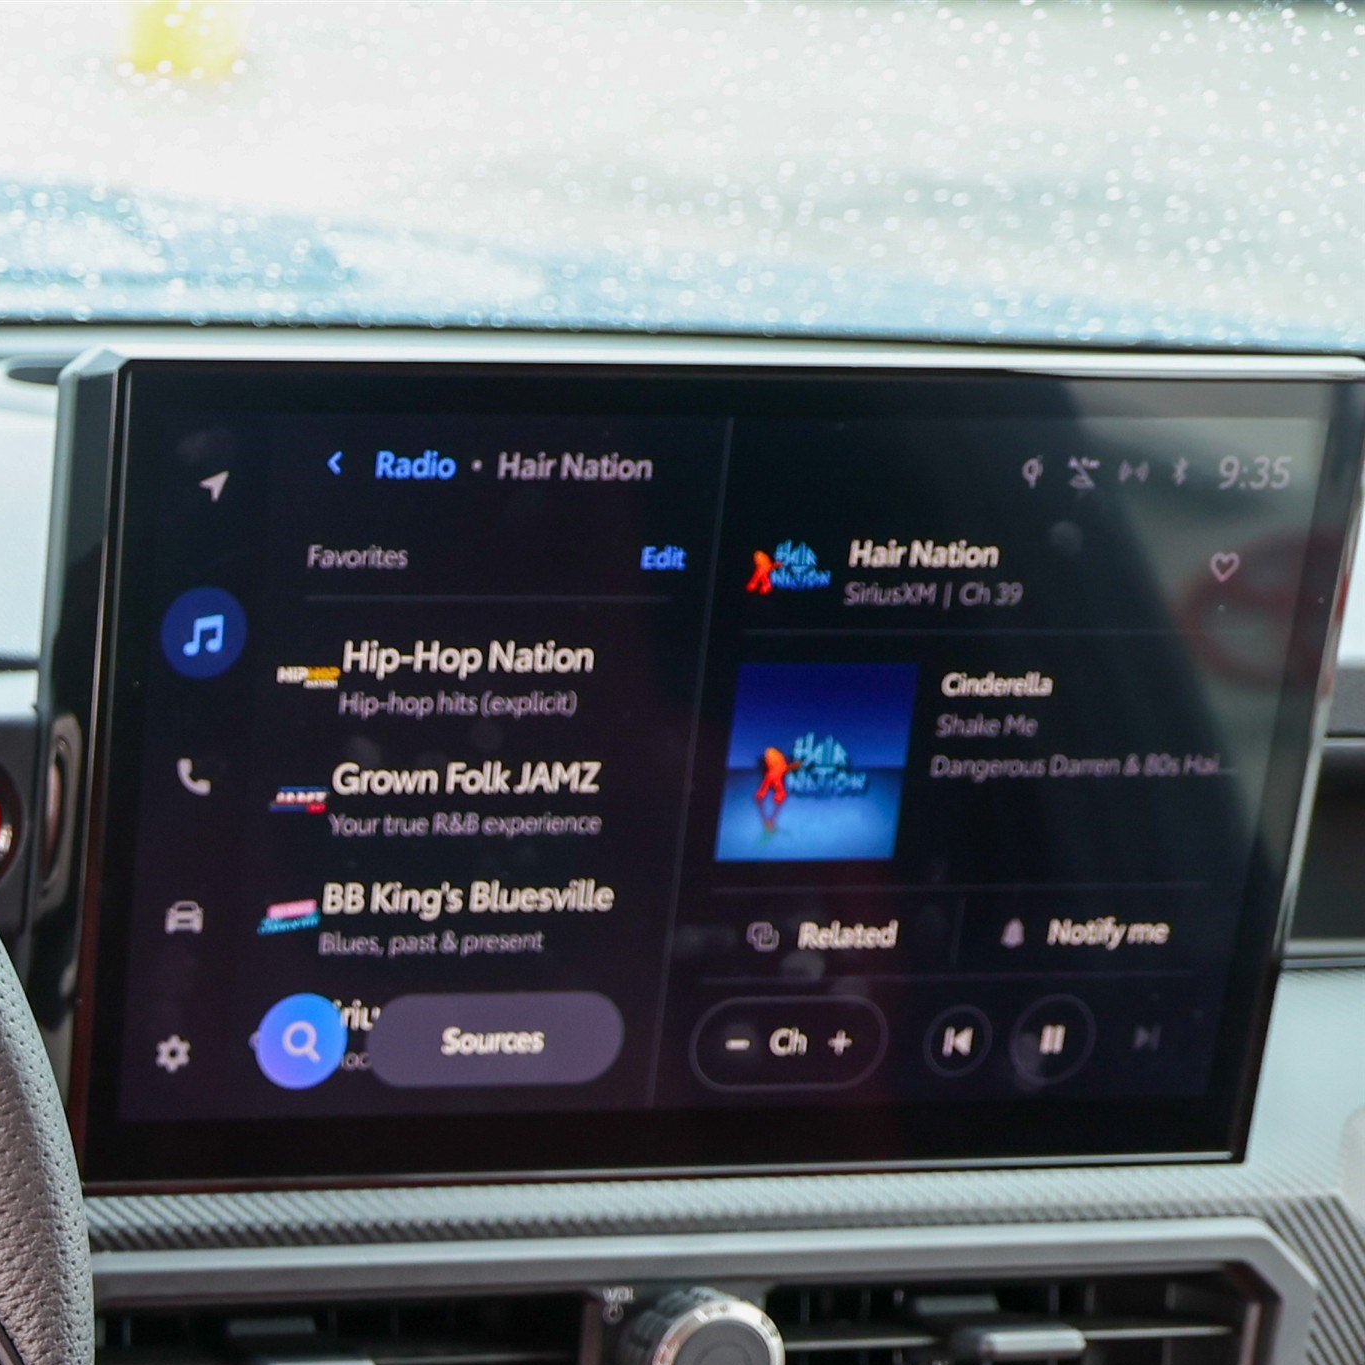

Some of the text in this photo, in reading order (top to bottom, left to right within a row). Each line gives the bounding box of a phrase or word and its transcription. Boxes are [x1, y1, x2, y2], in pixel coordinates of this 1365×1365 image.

[375, 450, 653, 480] Radio Hair Nation
[1218, 455, 1292, 490] 9:35
[307, 545, 408, 569] Favorites
[641, 546, 687, 570] Edit
[848, 539, 1000, 568] Hair Nation
[843, 581, 937, 606] SiriusXM
[958, 580, 991, 606] Ch
[994, 580, 1024, 606] 39
[342, 640, 595, 680] Hip-Hop Nation
[941, 671, 1053, 697] Cinderella
[339, 691, 578, 718] Hip-hop hits (explicit)
[936, 713, 1039, 738] Shake Me
[332, 762, 602, 795] Grown Folk JAMZ
[930, 753, 1046, 783] Dangerous
[329, 814, 602, 838] Your true R&B experience
[322, 878, 615, 921] BB King's Bluesville
[319, 931, 543, 957] Blues, past & present
[798, 920, 897, 950] Related
[1047, 917, 1169, 950] Notify me
[441, 1027, 545, 1055] Sources
[769, 1028, 808, 1057] Ch
